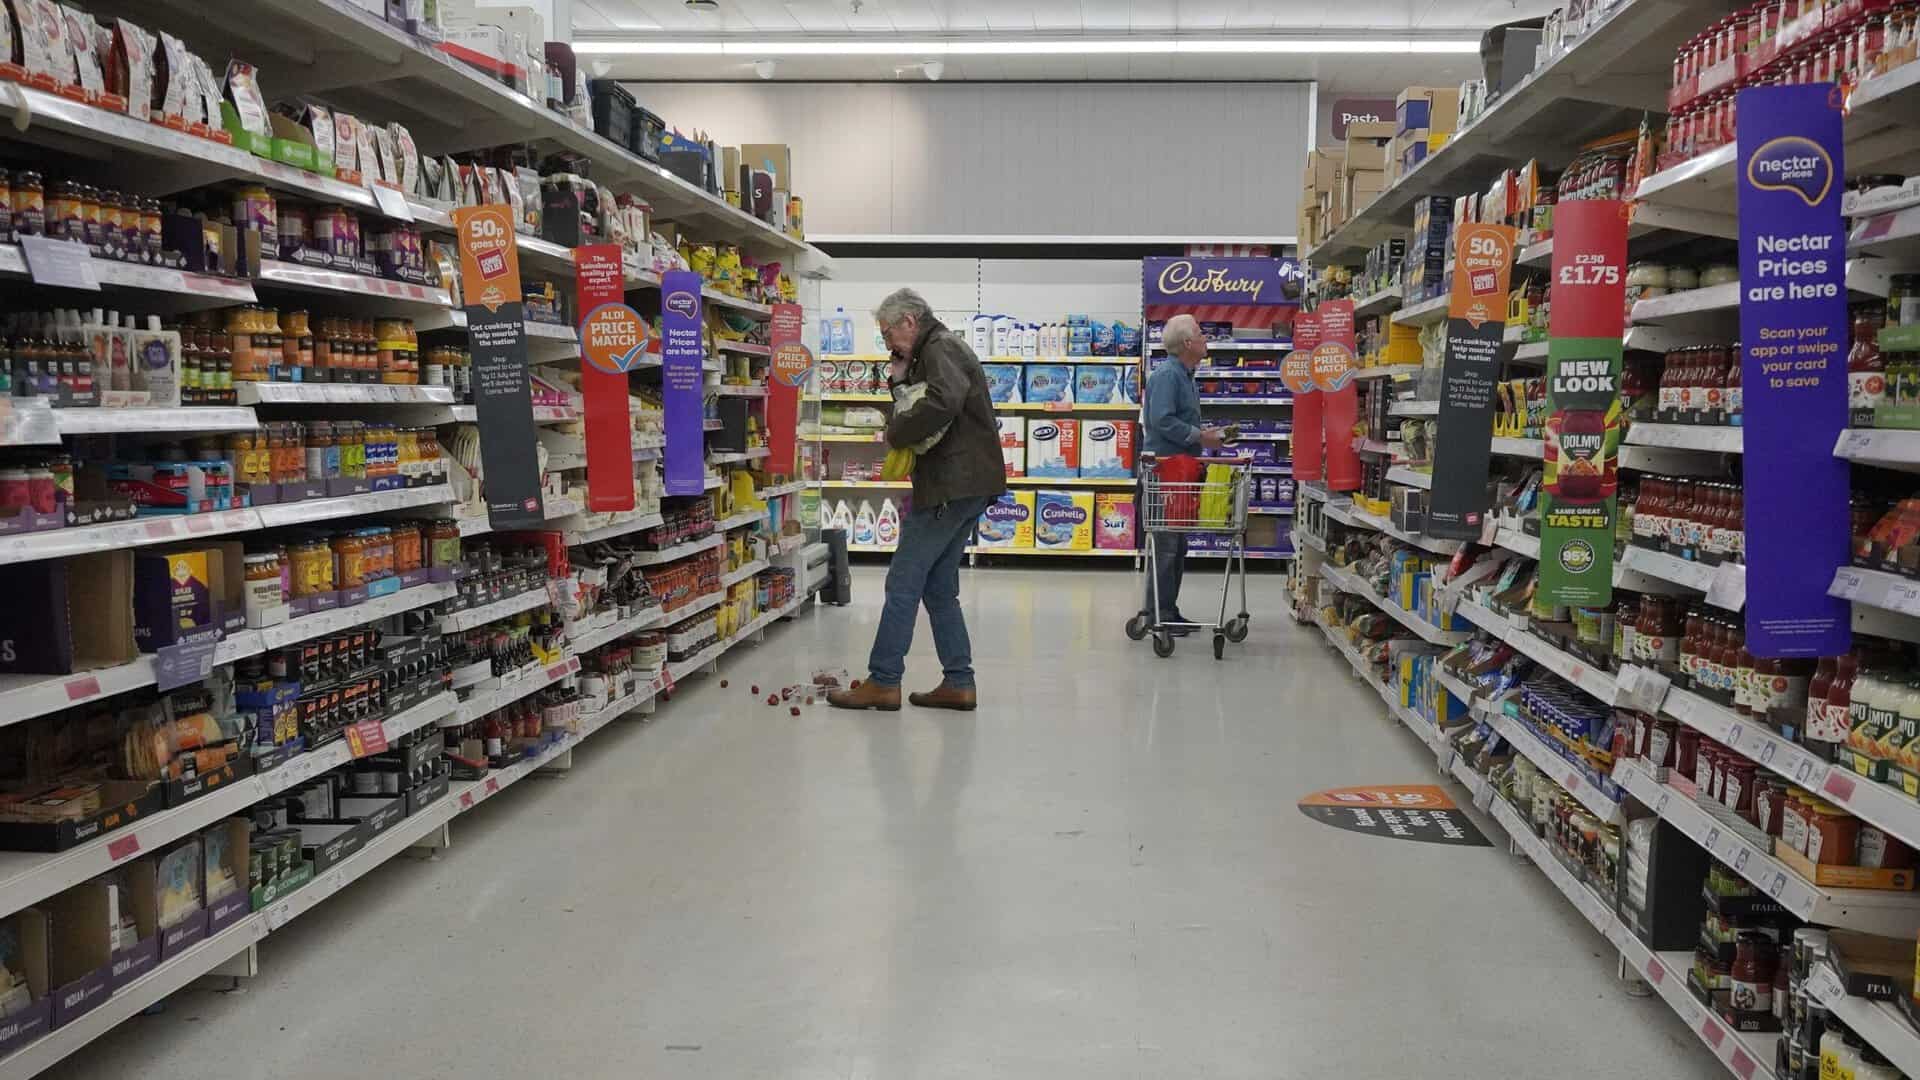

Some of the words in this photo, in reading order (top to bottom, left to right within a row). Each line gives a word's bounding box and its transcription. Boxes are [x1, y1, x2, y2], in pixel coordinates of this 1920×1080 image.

[1342, 112, 1380, 125] Pasta
[1759, 155, 1820, 173] nectar
[1781, 168, 1813, 181] prices
[470, 219, 504, 238] 50p
[470, 241, 493, 251] goes
[496, 239, 507, 247] to
[1469, 237, 1503, 257] 50p
[1757, 233, 1832, 254] Nectar
[580, 262, 618, 270] Sainsbury's
[1466, 257, 1490, 267] goes
[1491, 258, 1503, 267] to
[1758, 257, 1828, 278] Prices
[1559, 265, 1620, 285] £1.75
[1158, 261, 1264, 303] Cadbury
[1749, 284, 1785, 302] are
[1789, 281, 1838, 300] here
[601, 310, 625, 320] ALDI
[484, 321, 513, 331] cooking
[590, 321, 636, 335] PRICE
[474, 332, 491, 340] help
[669, 329, 697, 337] Nectar
[1760, 327, 1796, 340] Scan
[1798, 326, 1829, 341] your
[492, 338, 516, 346] nation
[592, 335, 637, 348] MATCH
[669, 338, 696, 346] Prices
[1449, 336, 1462, 344] Get
[1463, 338, 1492, 347] cooking
[681, 346, 699, 355] here
[1451, 344, 1468, 353] help
[1750, 346, 1779, 360] app
[1781, 344, 1794, 355] or
[1796, 341, 1838, 356] swipe
[777, 352, 807, 361] PRICE
[1314, 354, 1347, 365] PRICE
[1455, 352, 1467, 360] the
[1467, 354, 1492, 362] nation
[777, 361, 807, 369] MATCH
[1314, 364, 1348, 374] MATCH
[1560, 360, 1610, 377] NEW
[1762, 362, 1793, 375] your
[1794, 357, 1828, 371] card
[1553, 377, 1615, 393] LOOK
[1770, 376, 1784, 389] to
[1785, 376, 1820, 388] save
[1563, 434, 1601, 450] DOLMIO
[986, 505, 1028, 518] Cushelle
[1043, 508, 1085, 522] Cushelle
[1576, 507, 1601, 515] GREAT
[1104, 518, 1127, 529] Surf
[1546, 514, 1609, 528] TASTE!
[1562, 549, 1592, 562] 95%
[1346, 807, 1377, 827] poverty
[1378, 808, 1404, 824] tackle
[1407, 815, 1431, 827] help
[1388, 823, 1415, 836] food
[1437, 819, 1465, 840] cooking
[65, 989, 85, 1009] INDIAN
